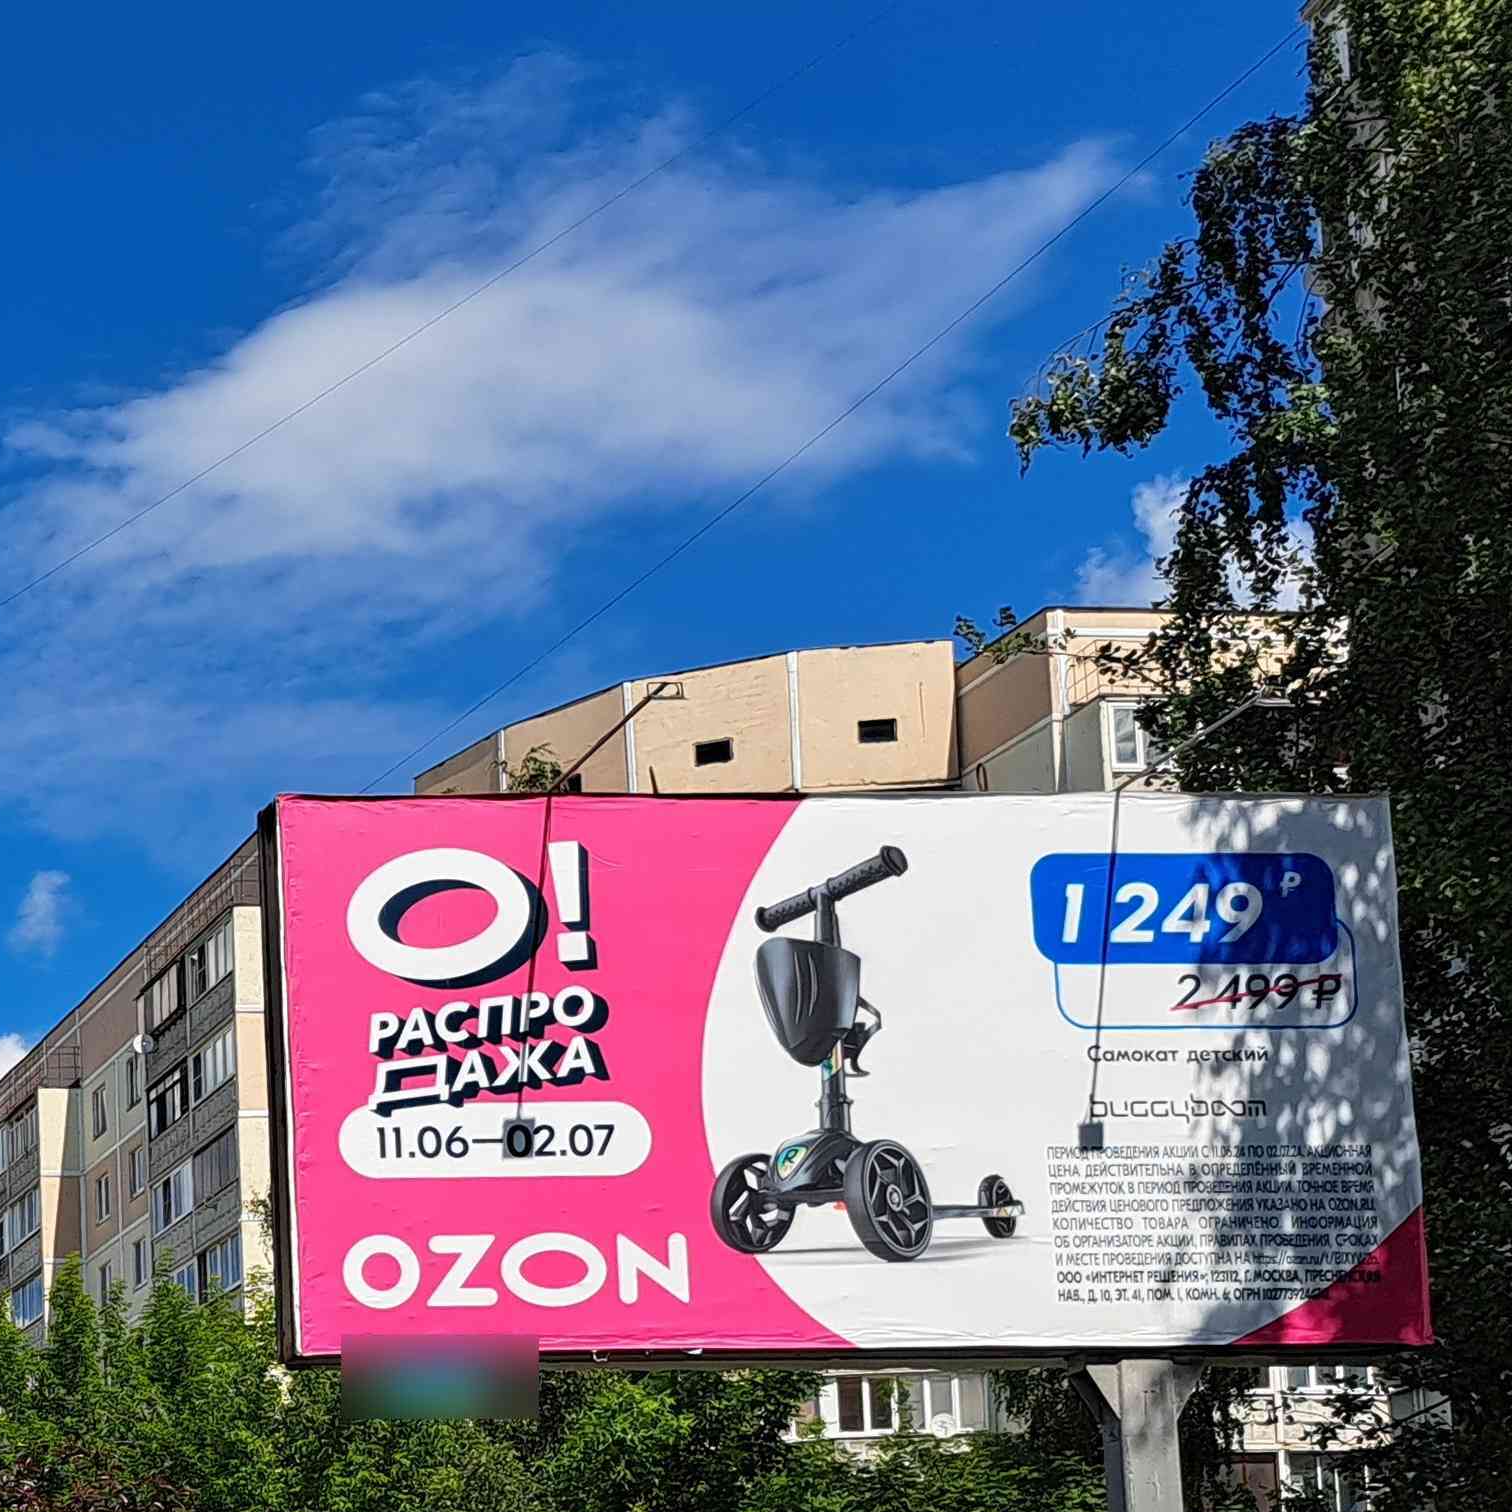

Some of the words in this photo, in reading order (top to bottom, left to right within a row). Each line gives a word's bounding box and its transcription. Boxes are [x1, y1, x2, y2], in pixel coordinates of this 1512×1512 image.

[369, 985, 602, 1056] РАСПРО
[1087, 1045, 1179, 1062] Самокат
[1186, 1046, 1269, 1064] детский
[368, 1036, 603, 1114] ДАЖА
[1047, 1146, 1088, 1160] ПЕРИОД
[1091, 1146, 1160, 1160] ПРОВЕДЕНИЯ
[1162, 1145, 1198, 1159] АКЦИИ
[1248, 1145, 1264, 1157] ПО
[1048, 1164, 1081, 1178] ЦЕНА
[1085, 1162, 1184, 1178] ДЕЙСТВИТЕЛЬНА
[1189, 1164, 1198, 1176] В
[1302, 1160, 1373, 1177] ВРЕМЕННОЙ
[1049, 1182, 1126, 1195] ПРОМЕЖУТОК
[1128, 1182, 1136, 1194] В
[1137, 1181, 1181, 1196] ПЕРИОД
[1183, 1180, 1253, 1195] ПРОВЕДЕНИЯ
[1296, 1180, 1338, 1194] ТОЧНОЕ
[1341, 1180, 1375, 1194] ВРЕМЯ
[1052, 1198, 1106, 1213] ДЕЙСТВИЯ
[1109, 1199, 1169, 1213] ЦЕНОВОГО
[1172, 1199, 1254, 1213] ПРЕДЛОЖЕНИЯ
[1257, 1199, 1309, 1212] УКАЗАНО
[1311, 1199, 1326, 1212] НА
[1052, 1217, 1134, 1230] КОЛИЧЕСТВО
[1142, 1217, 1190, 1230] ТОВАРА
[1291, 1215, 1378, 1230] ИНФОРМАЦИЯ
[1054, 1235, 1070, 1248] ОБ
[1072, 1235, 1154, 1248] ОРГАНИЗАТОРЕ
[1200, 1234, 1258, 1248] ПРАВИЛАХ
[1335, 1232, 1379, 1247] СРОКАХ
[1055, 1253, 1064, 1266] И
[1066, 1253, 1100, 1266] МЕСТЕ
[1102, 1253, 1172, 1267] ПРОВЕДЕНИЯ
[1174, 1252, 1232, 1266] ДОСТУПНА
[1236, 1252, 1251, 1264] НА
[342, 1232, 690, 1309] OZON
[1057, 1271, 1082, 1284] ООО
[1085, 1271, 1145, 1283] «ИНТЕРНЕТ
[1233, 1288, 1260, 1300] ОГРН
